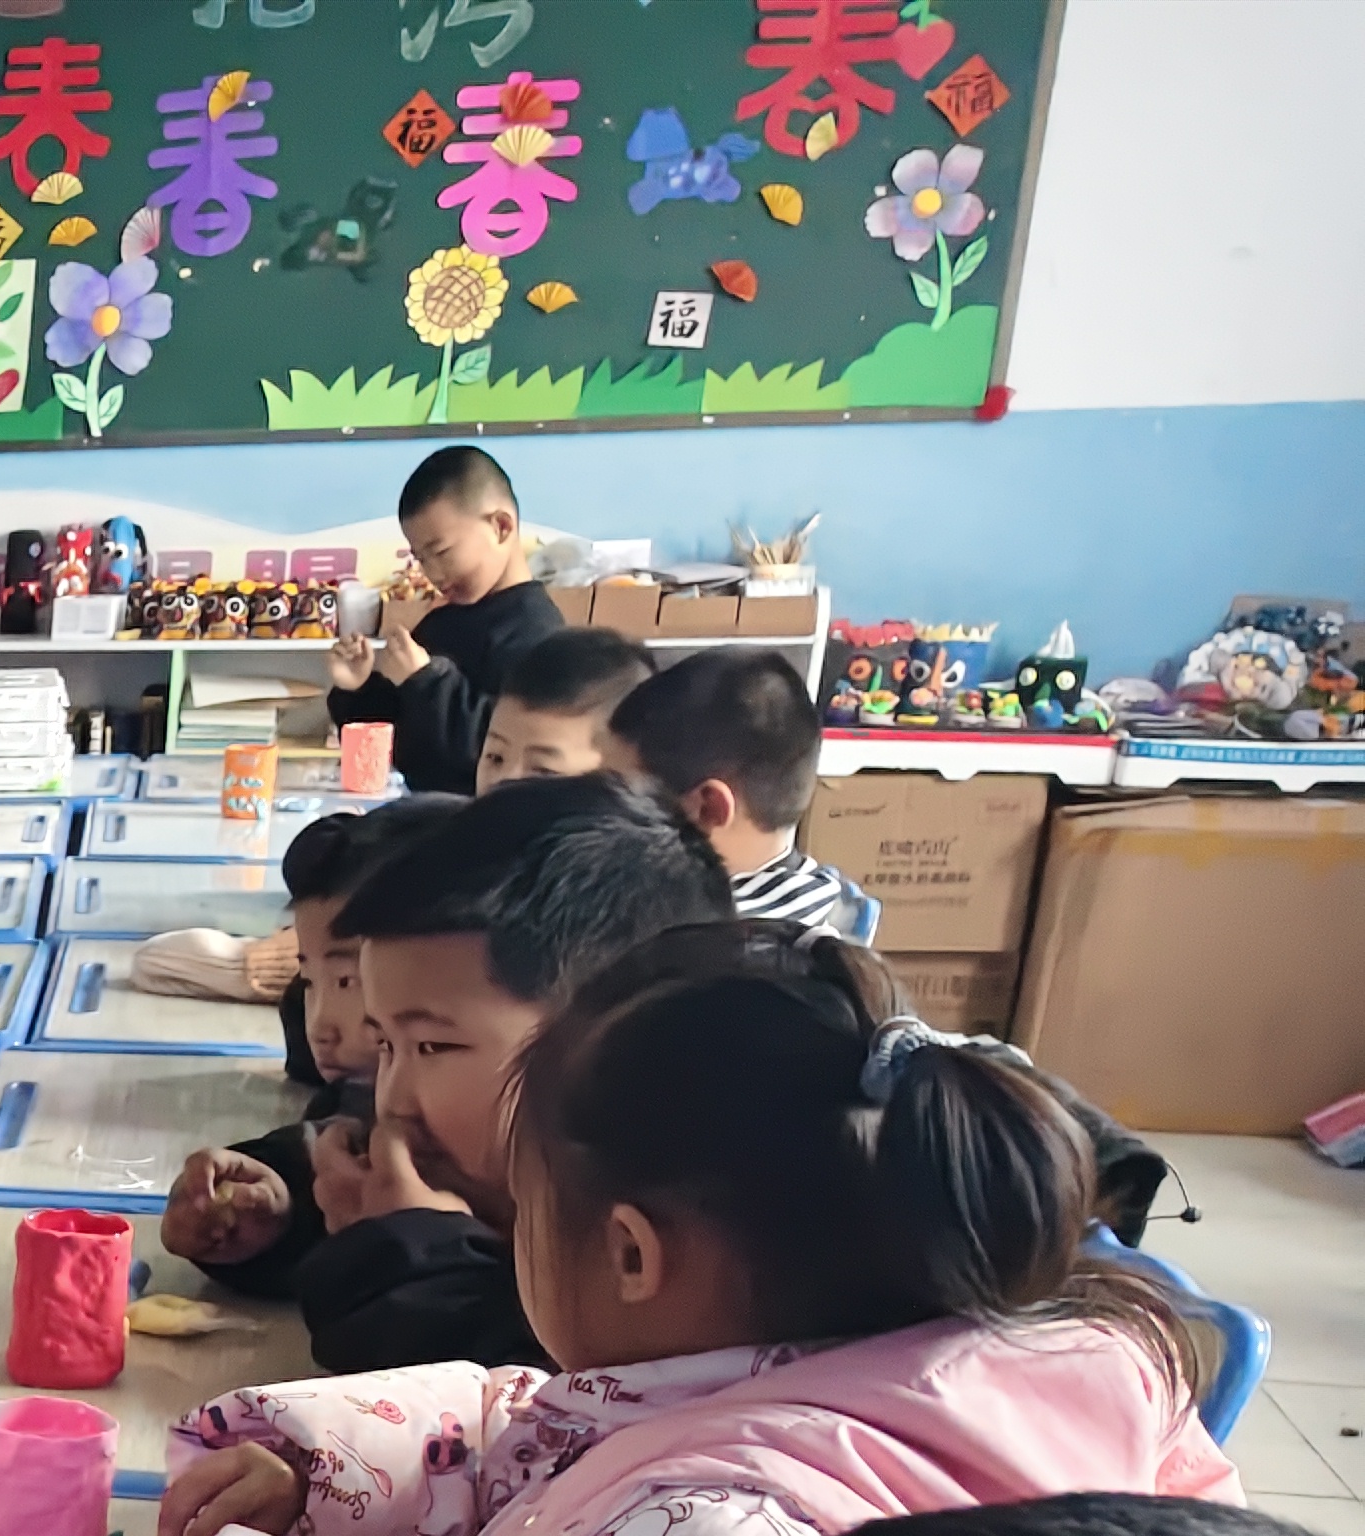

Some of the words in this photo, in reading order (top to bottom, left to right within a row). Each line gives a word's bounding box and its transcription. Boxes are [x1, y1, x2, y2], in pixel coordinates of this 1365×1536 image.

[396, 109, 439, 154] 福
[734, 0, 903, 157] 春
[147, 75, 279, 257] 春
[437, 70, 583, 258] 春
[658, 300, 699, 341] 福
